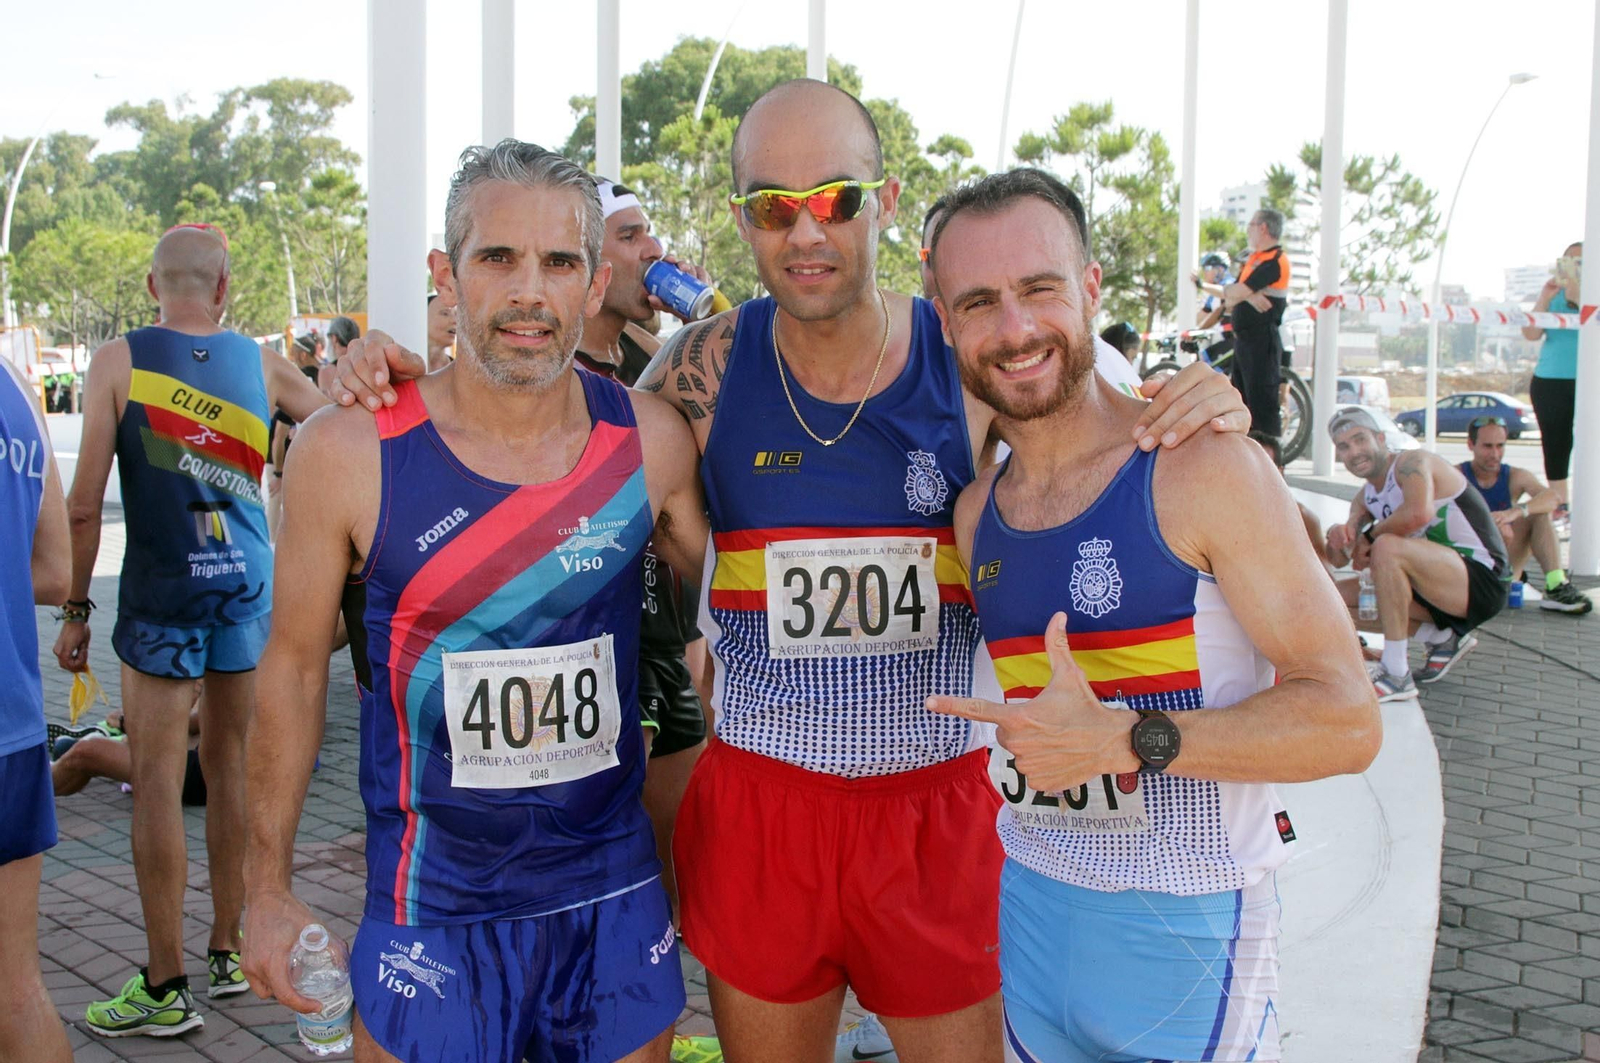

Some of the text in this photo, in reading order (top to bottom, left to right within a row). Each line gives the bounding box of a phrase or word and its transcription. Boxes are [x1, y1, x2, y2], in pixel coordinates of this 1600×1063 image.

[171, 388, 223, 421] CLUB
[415, 507, 469, 552] Joma
[557, 519, 629, 536] CLUB ATLETISMO
[772, 546, 919, 559] DIRECCIÓN GENERAL DE LA POLICÍA
[190, 562, 247, 579] Trigueros
[558, 553, 603, 574] Viso
[782, 564, 926, 638] 3204
[778, 637, 933, 656] AGRUPACIÓN DEPORTIVA
[450, 659, 495, 670] DIRECCIÓN
[496, 658, 539, 668] GENERAL
[540, 657, 551, 665] DE
[461, 667, 600, 750] 4048
[460, 740, 605, 766] AGRUPACIÓN DEPORTIVA
[529, 768, 549, 781] 4048
[1071, 815, 1144, 831] DEPORTIVA
[389, 939, 410, 954] CLUB
[378, 962, 417, 999] Viso
